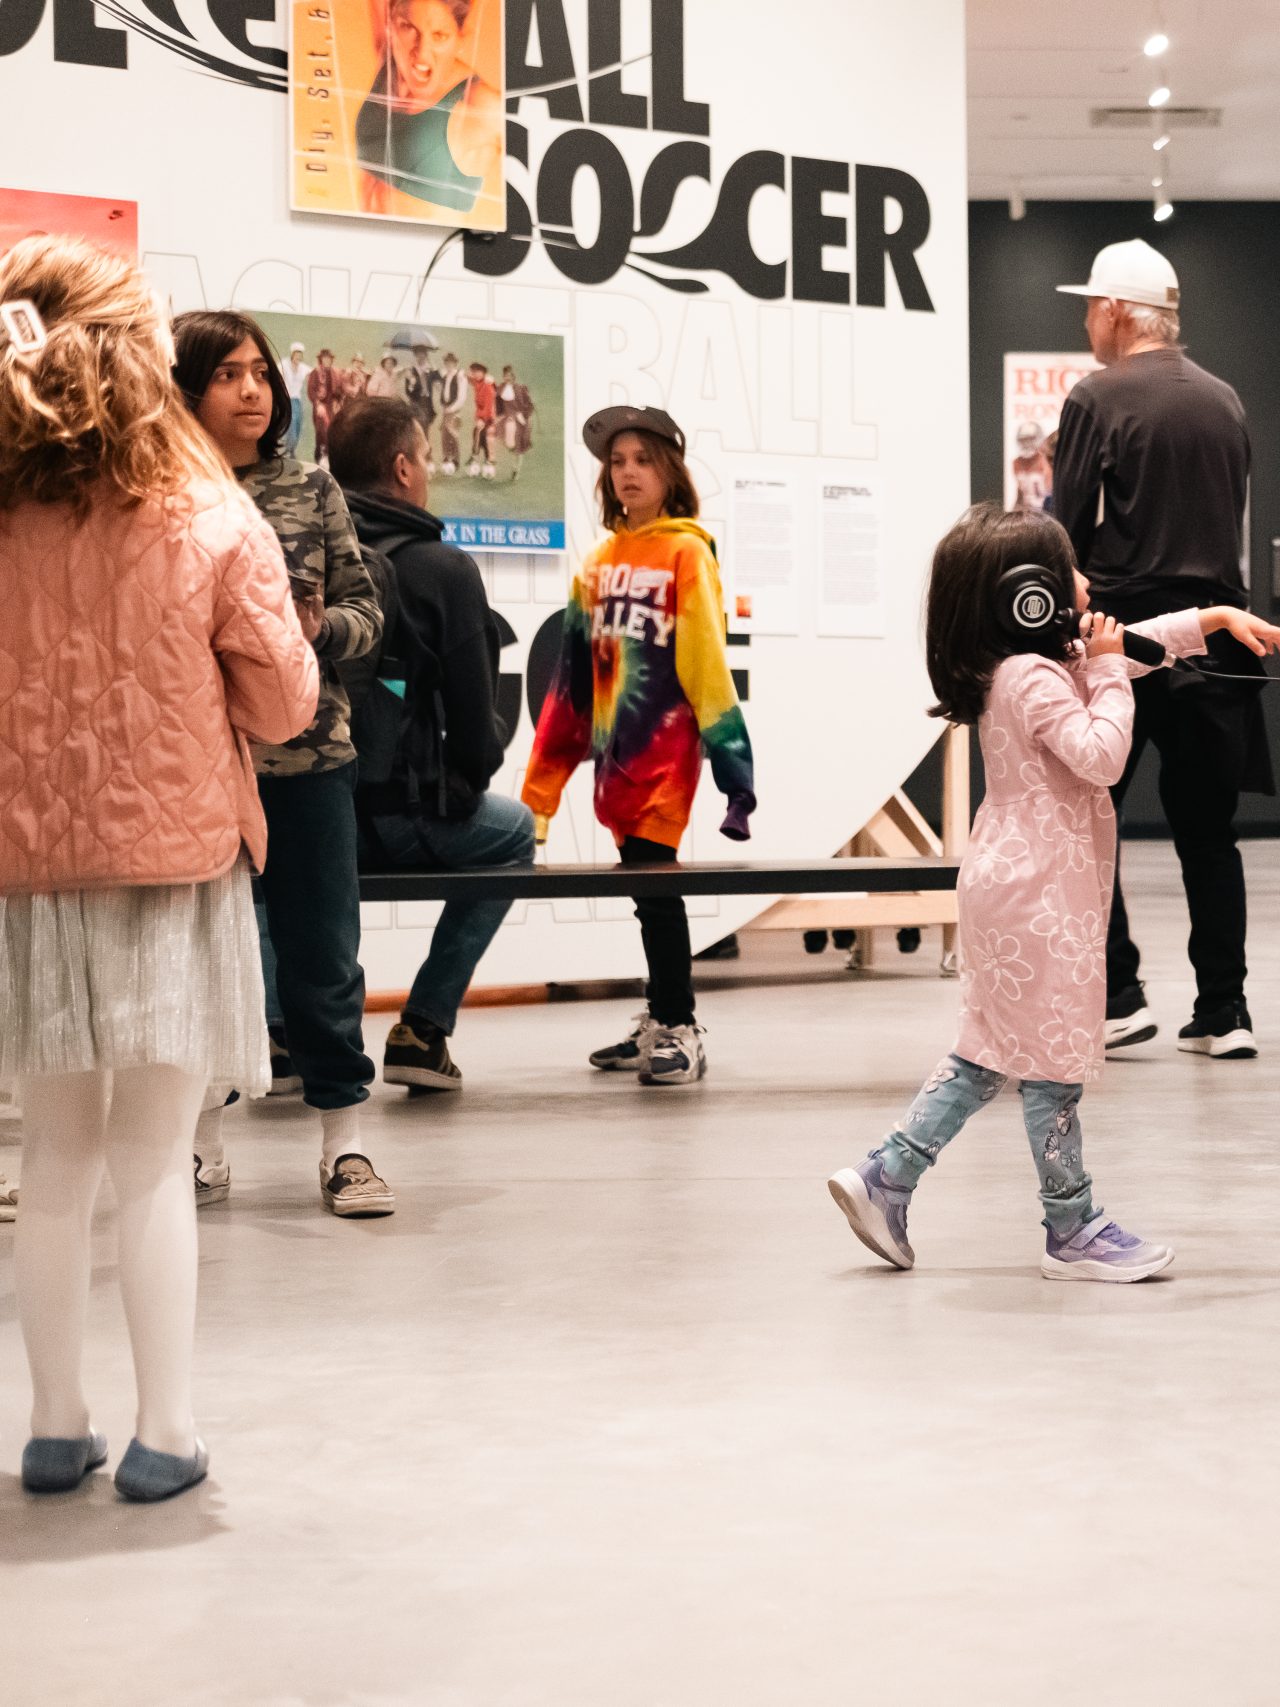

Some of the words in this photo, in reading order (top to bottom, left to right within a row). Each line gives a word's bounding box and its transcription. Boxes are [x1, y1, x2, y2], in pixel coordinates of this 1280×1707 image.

[460, 523, 476, 543] IN
[478, 524, 506, 544] THE
[508, 526, 550, 545] GRASS
